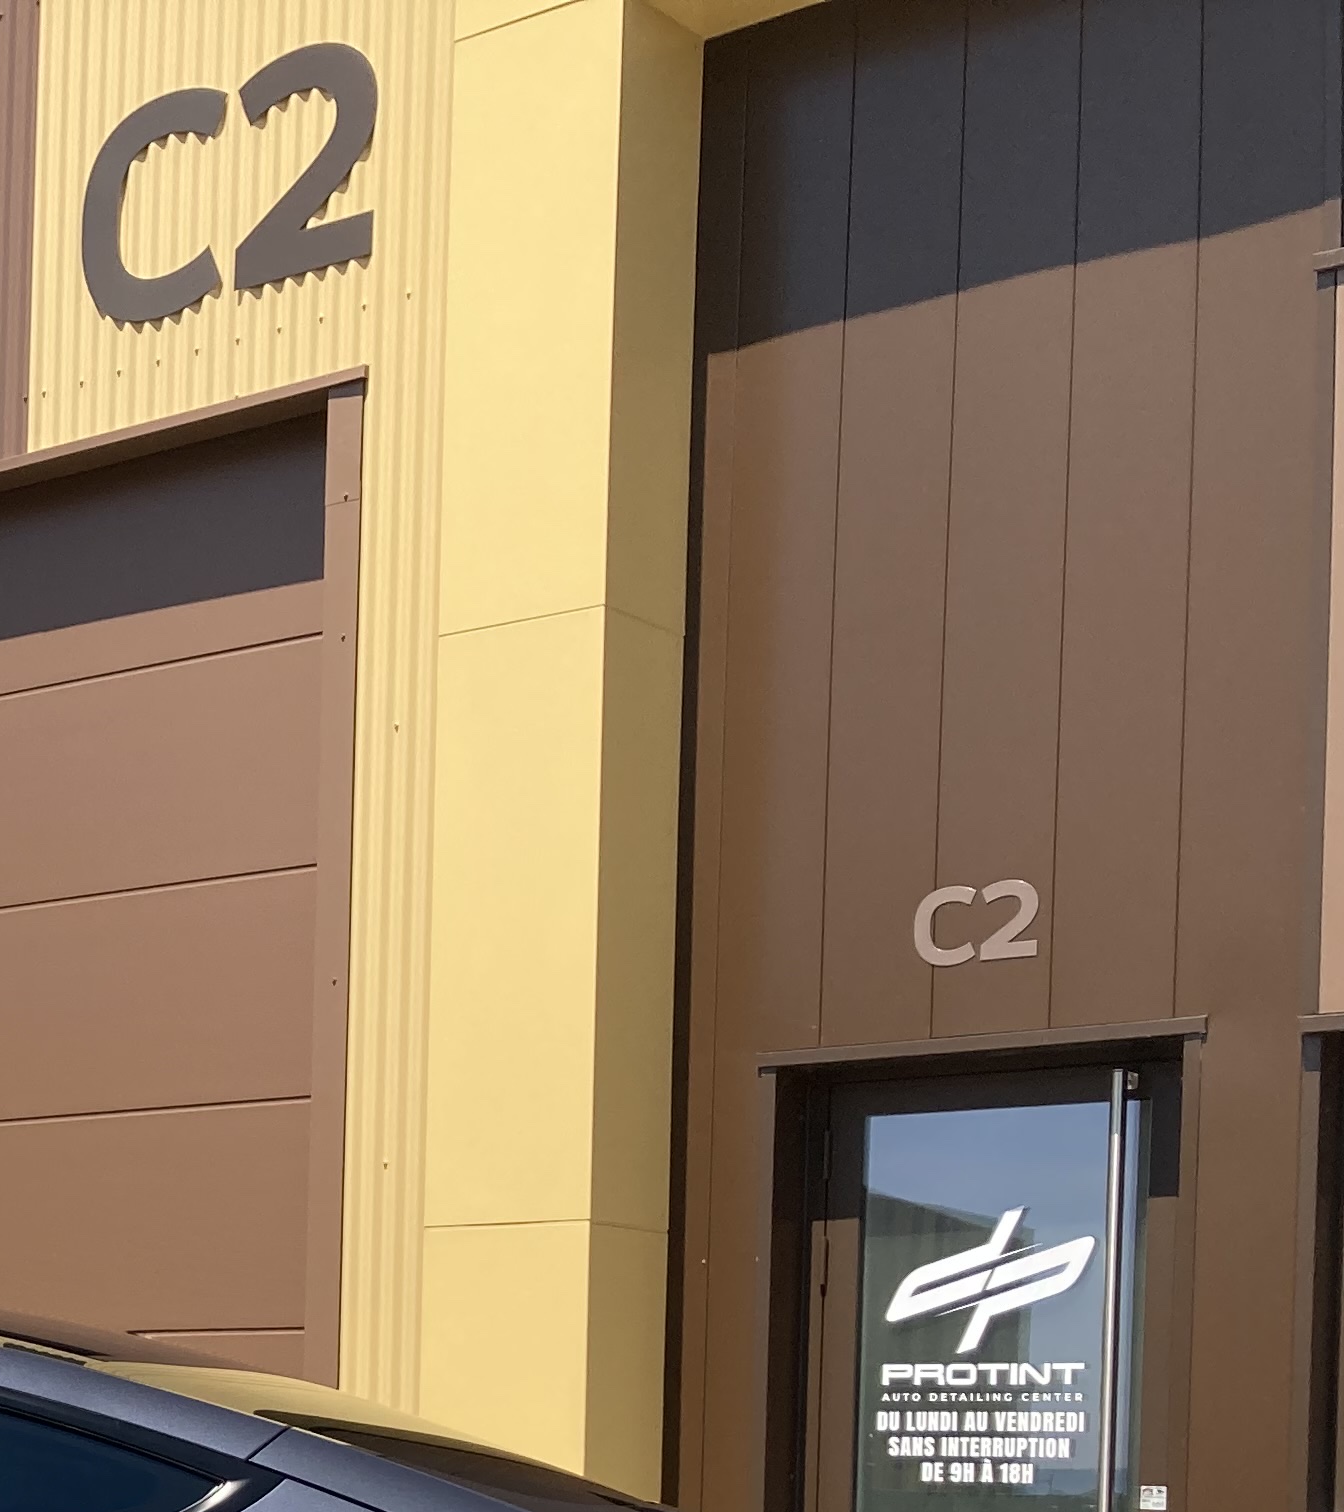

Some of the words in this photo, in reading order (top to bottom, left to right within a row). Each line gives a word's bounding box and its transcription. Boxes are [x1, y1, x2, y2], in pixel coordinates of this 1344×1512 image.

[82, 42, 378, 325] C2
[914, 879, 1039, 967] C2
[880, 1362, 1085, 1386] PROTINT
[882, 1393, 921, 1402] AUTO
[929, 1392, 1013, 1402] DETAILING
[1021, 1392, 1083, 1402] CENTER
[876, 1411, 900, 1431] DU
[906, 1411, 958, 1431] LUNDI
[963, 1411, 988, 1431] AU
[995, 1411, 1085, 1432] VENDREDI
[888, 1436, 936, 1457] SANS
[941, 1437, 1070, 1458] INTERRUPTION
[921, 1462, 944, 1482] DE
[950, 1462, 974, 1483] 9H
[981, 1458, 993, 1483] À
[999, 1463, 1034, 1484] 18H
